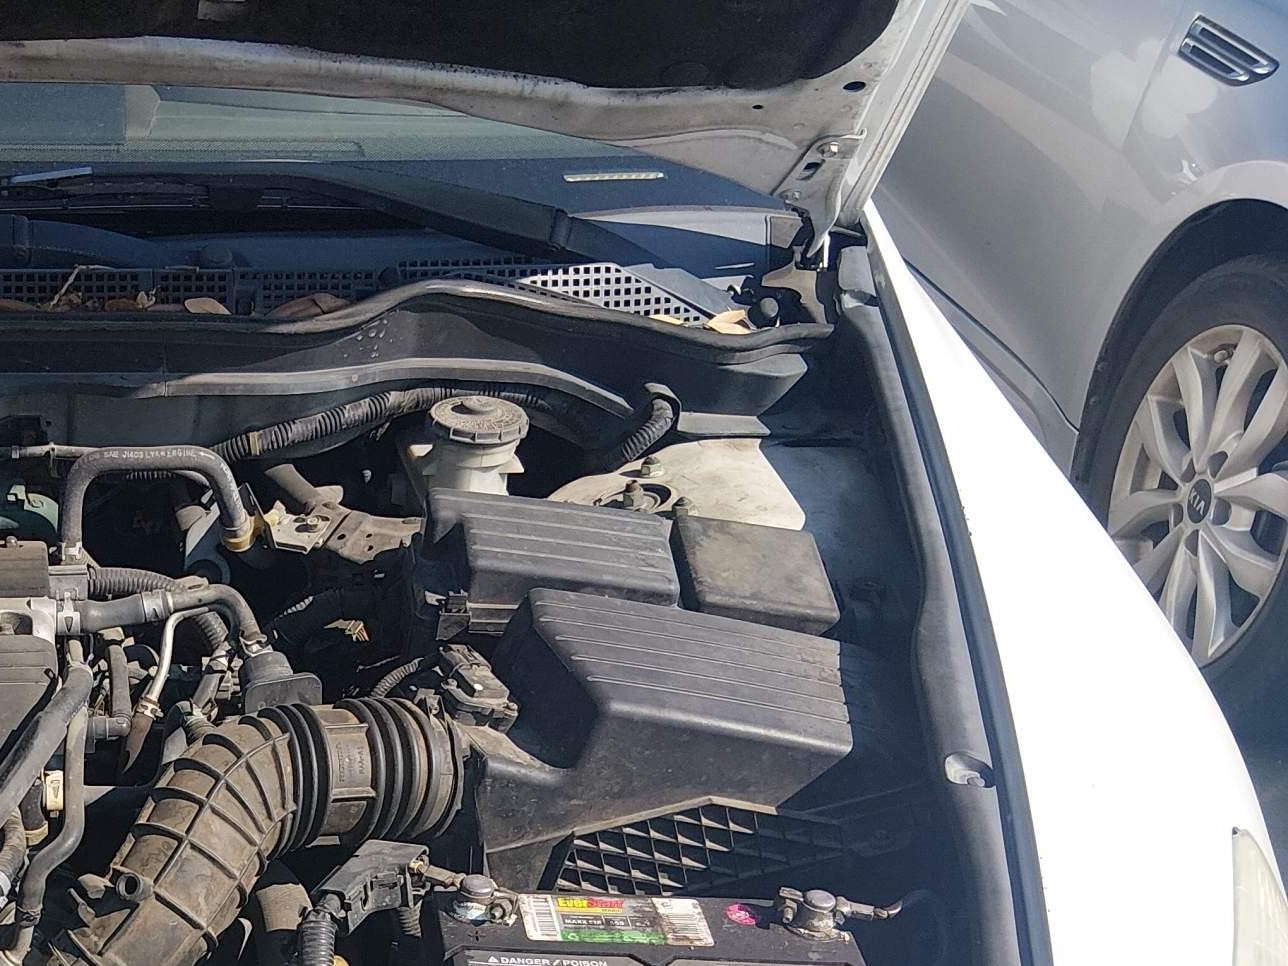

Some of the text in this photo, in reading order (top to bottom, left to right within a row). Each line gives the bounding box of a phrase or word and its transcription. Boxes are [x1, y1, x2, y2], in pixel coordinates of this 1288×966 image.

[1190, 487, 1206, 516] KIA
[500, 956, 550, 966] DANGER
[562, 959, 608, 966] POISON
